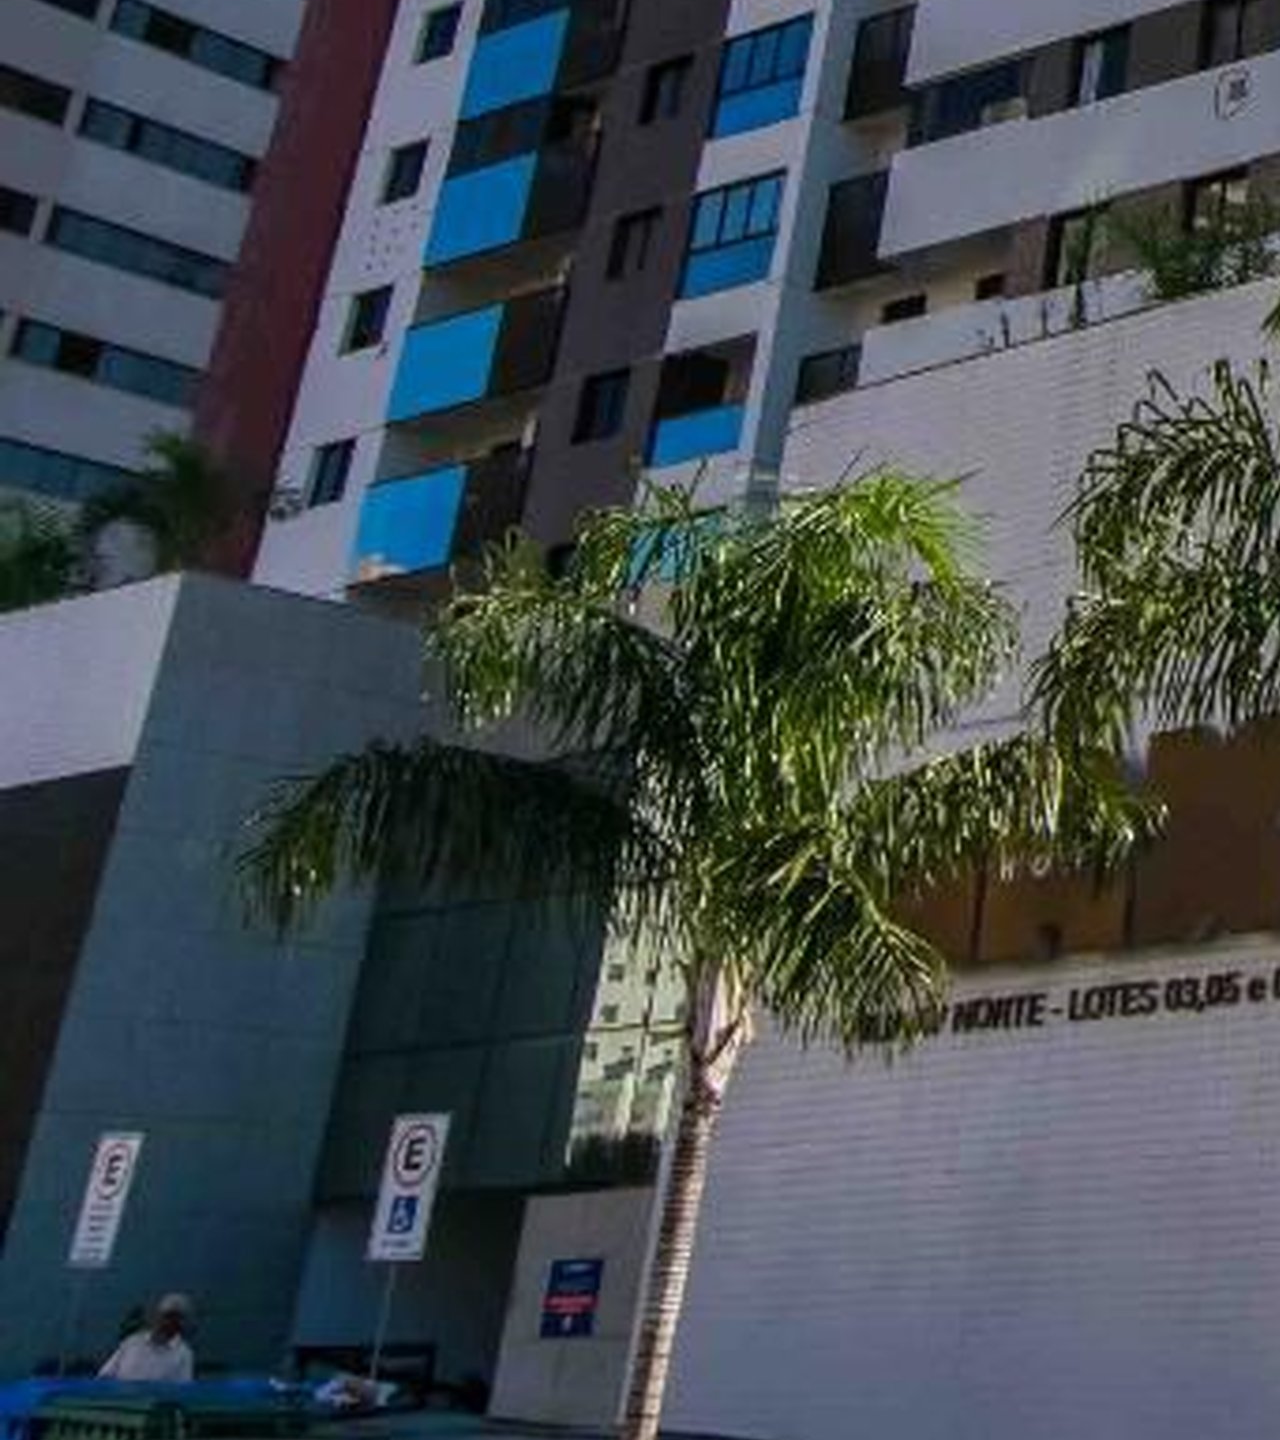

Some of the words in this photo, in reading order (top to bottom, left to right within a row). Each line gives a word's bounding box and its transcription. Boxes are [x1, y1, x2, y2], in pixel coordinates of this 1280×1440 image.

[1068, 981, 1160, 1021] LOTES
[1248, 977, 1267, 1002] e
[102, 1154, 124, 1186] E
[402, 1137, 426, 1170] E
